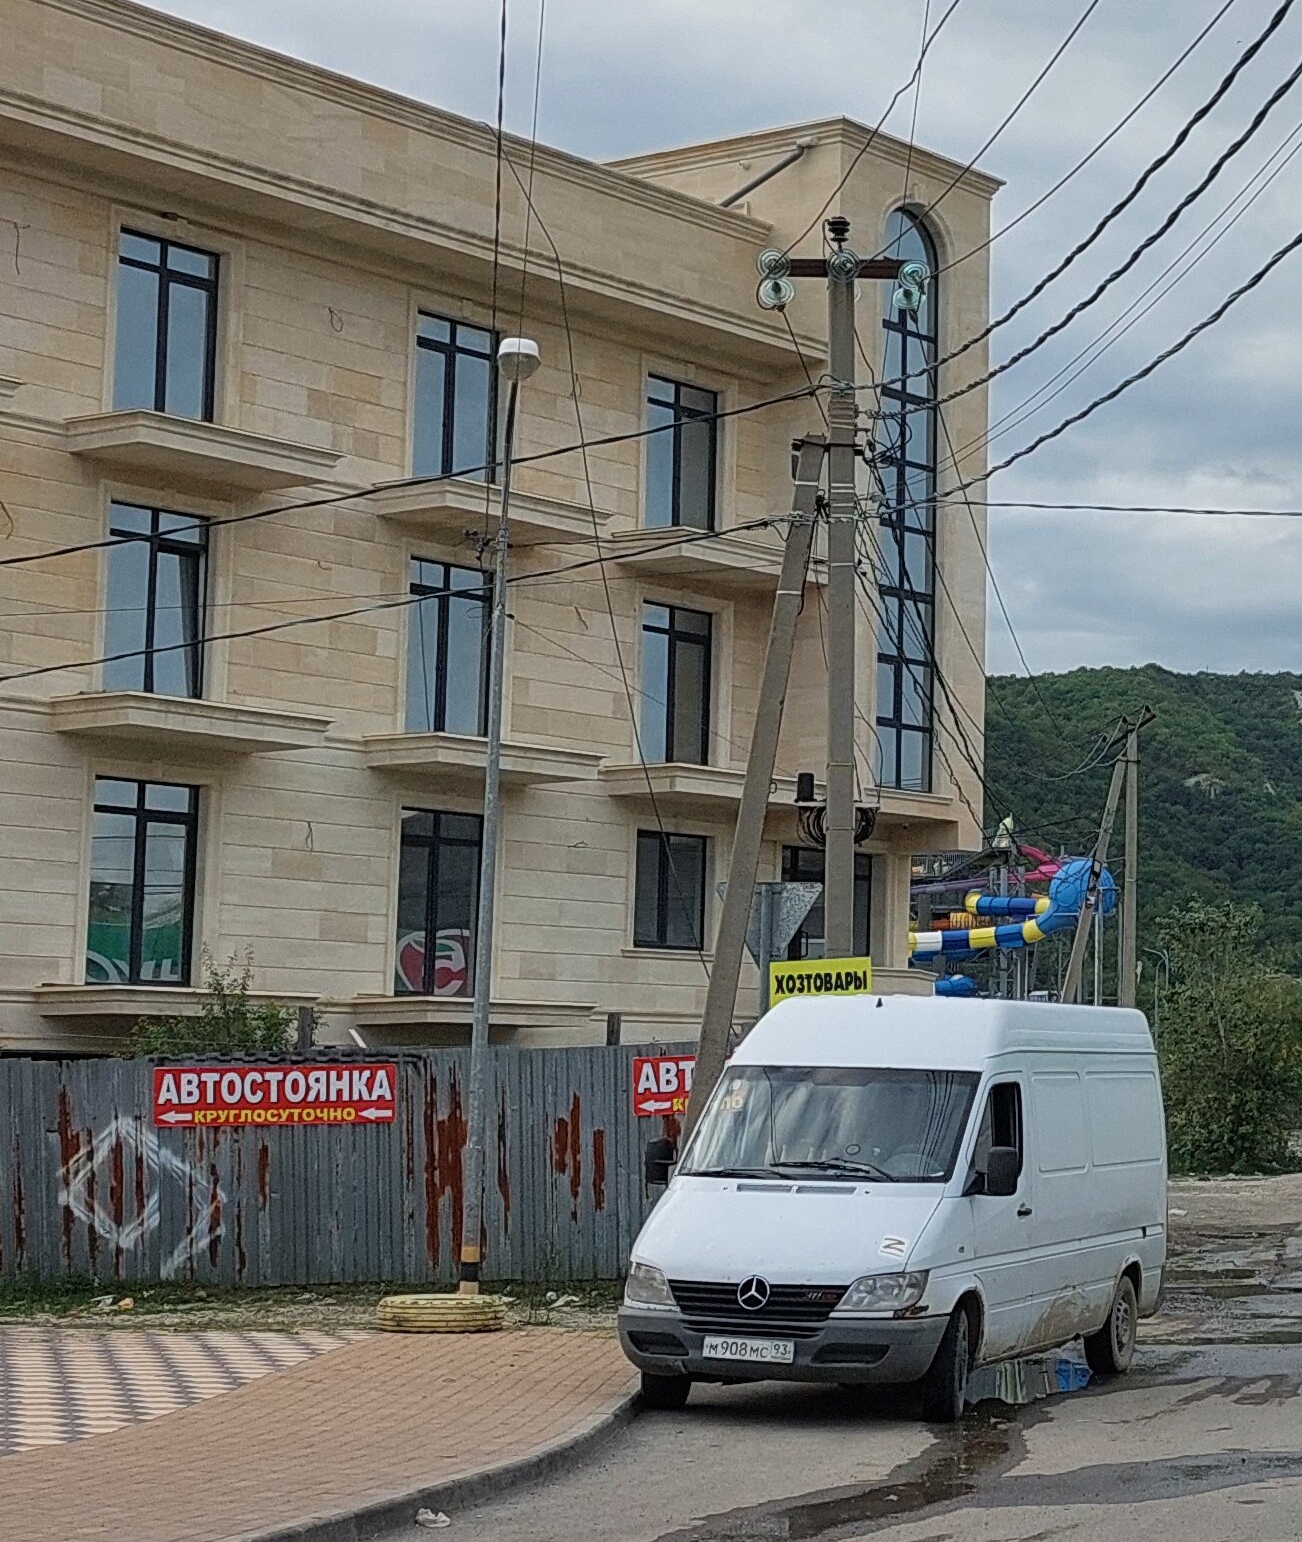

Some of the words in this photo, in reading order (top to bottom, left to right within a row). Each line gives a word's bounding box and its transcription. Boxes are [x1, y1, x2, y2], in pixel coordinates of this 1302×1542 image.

[774, 969, 868, 995] ХОЗТОВАРЫ
[157, 1069, 393, 1105] АВТОСТОЯНКА
[194, 1107, 357, 1124] КРУГЛОСУТОЧНО
[773, 1343, 788, 1356] 93
